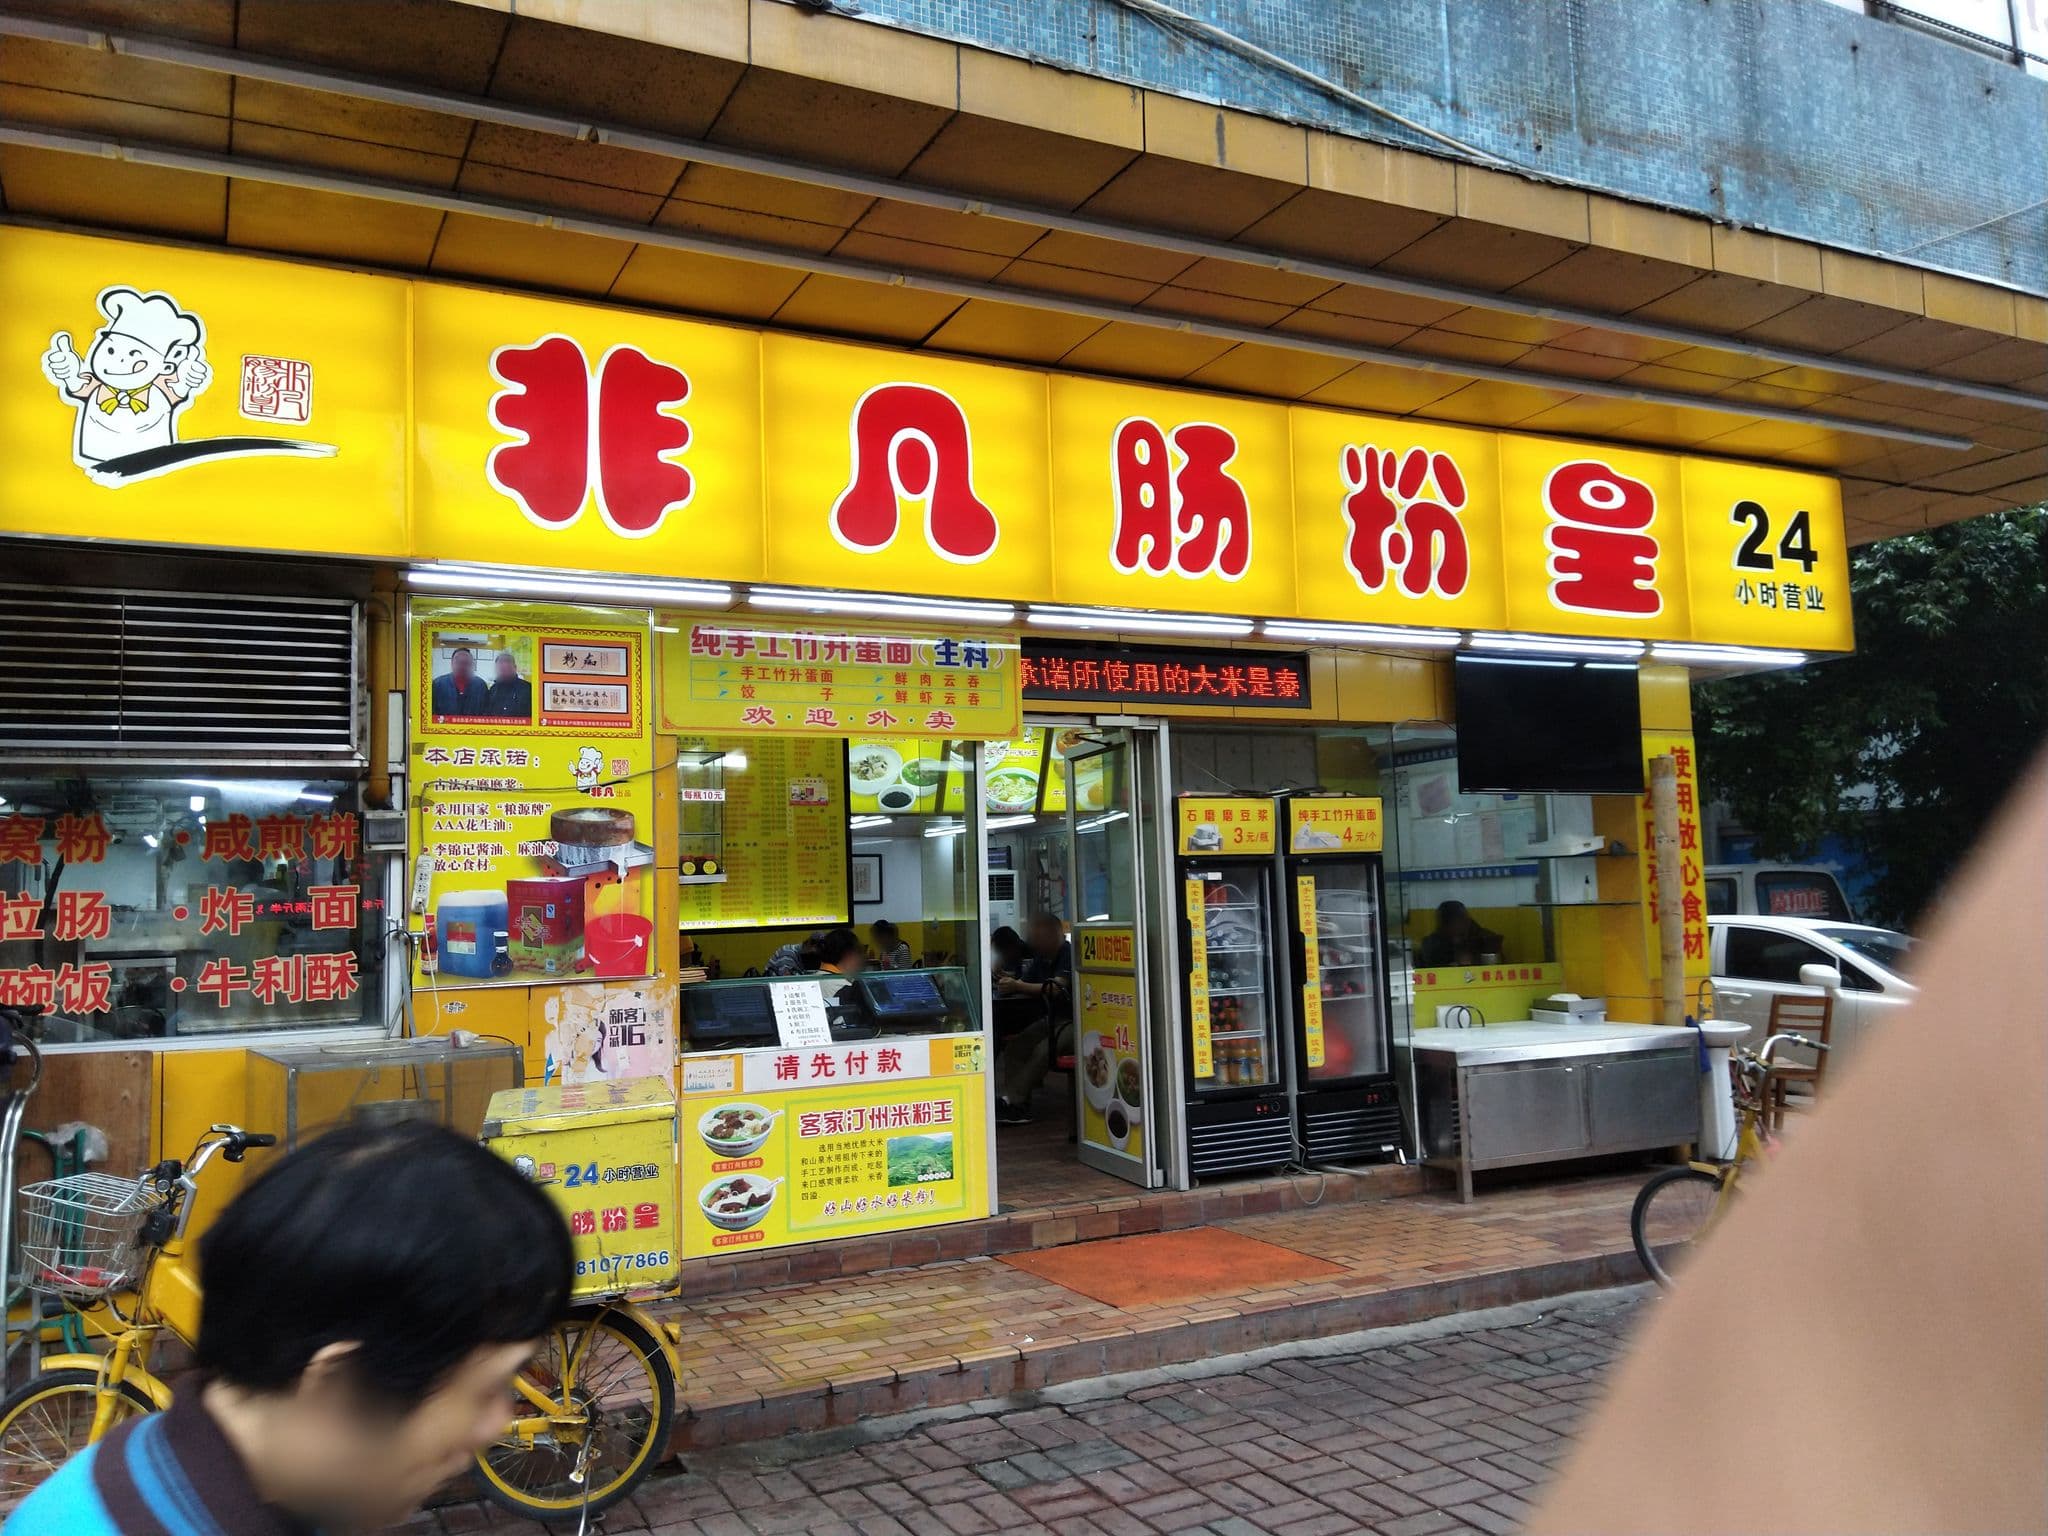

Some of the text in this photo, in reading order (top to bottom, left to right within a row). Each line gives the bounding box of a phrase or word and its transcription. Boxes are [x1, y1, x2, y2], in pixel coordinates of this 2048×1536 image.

[489, 334, 1662, 616] 非凡肠粉皇
[1732, 500, 1818, 573] 24
[1736, 579, 1825, 611] 小时营业
[741, 667, 980, 688] 手工竹升蛋面 鲜肉云吞
[740, 685, 980, 705] 饺子 鲜虾云吞
[684, 790, 723, 800] 每瓶10元
[1186, 808, 1269, 823] 石磨磨豆浆
[1298, 808, 1378, 823] 纯手工竹升蛋面
[202, 812, 359, 863] 咸煎饼
[0, 890, 111, 942] 拉肠
[198, 950, 359, 1008] 牛利酥
[774, 1047, 902, 1081] 请先付款
[799, 1099, 954, 1138] 客家汀州米粉王
[565, 1162, 659, 1189] 24 小时营业
[576, 1251, 669, 1276] 81077866
